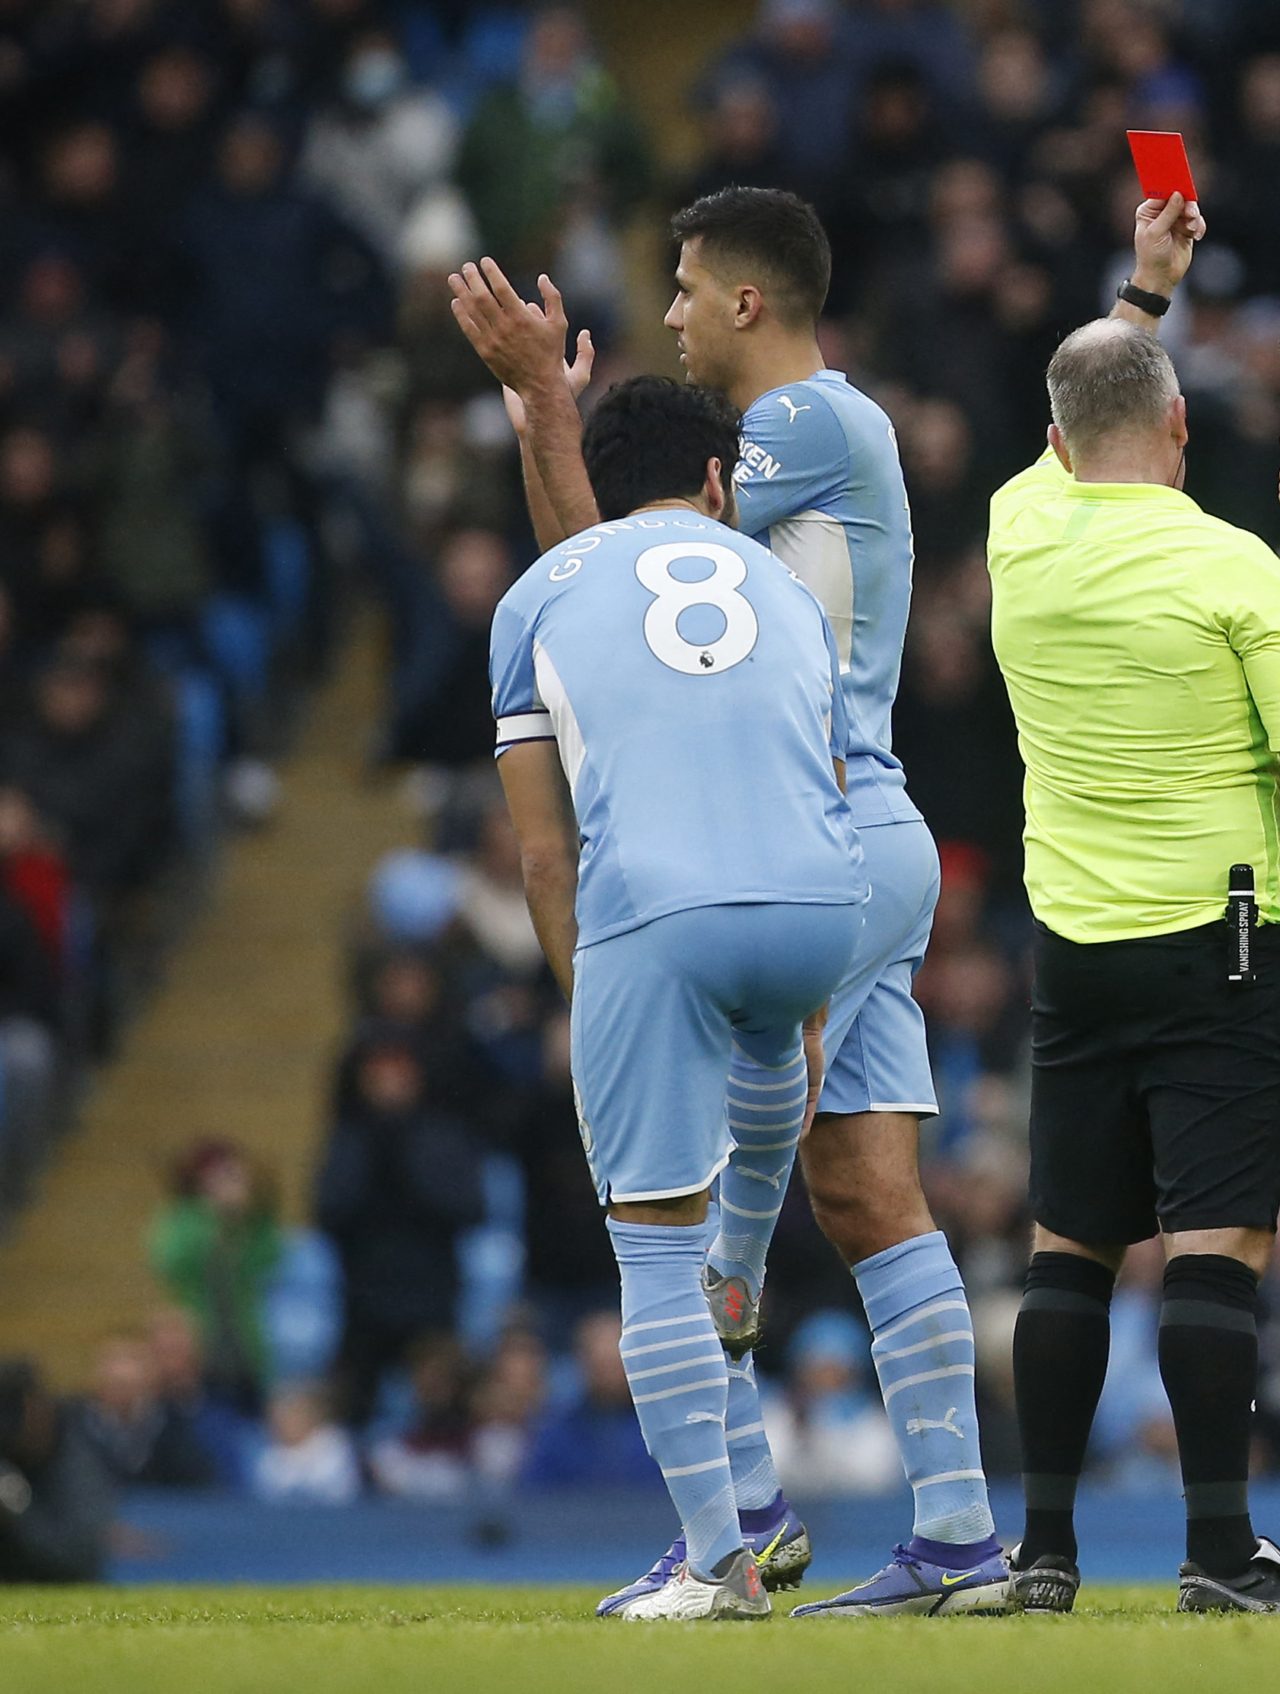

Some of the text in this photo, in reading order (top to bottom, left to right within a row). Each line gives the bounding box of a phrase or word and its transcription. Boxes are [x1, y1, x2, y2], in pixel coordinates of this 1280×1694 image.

[634, 541, 759, 676] 8
[1238, 901, 1250, 973] VANISHING SPRAY
